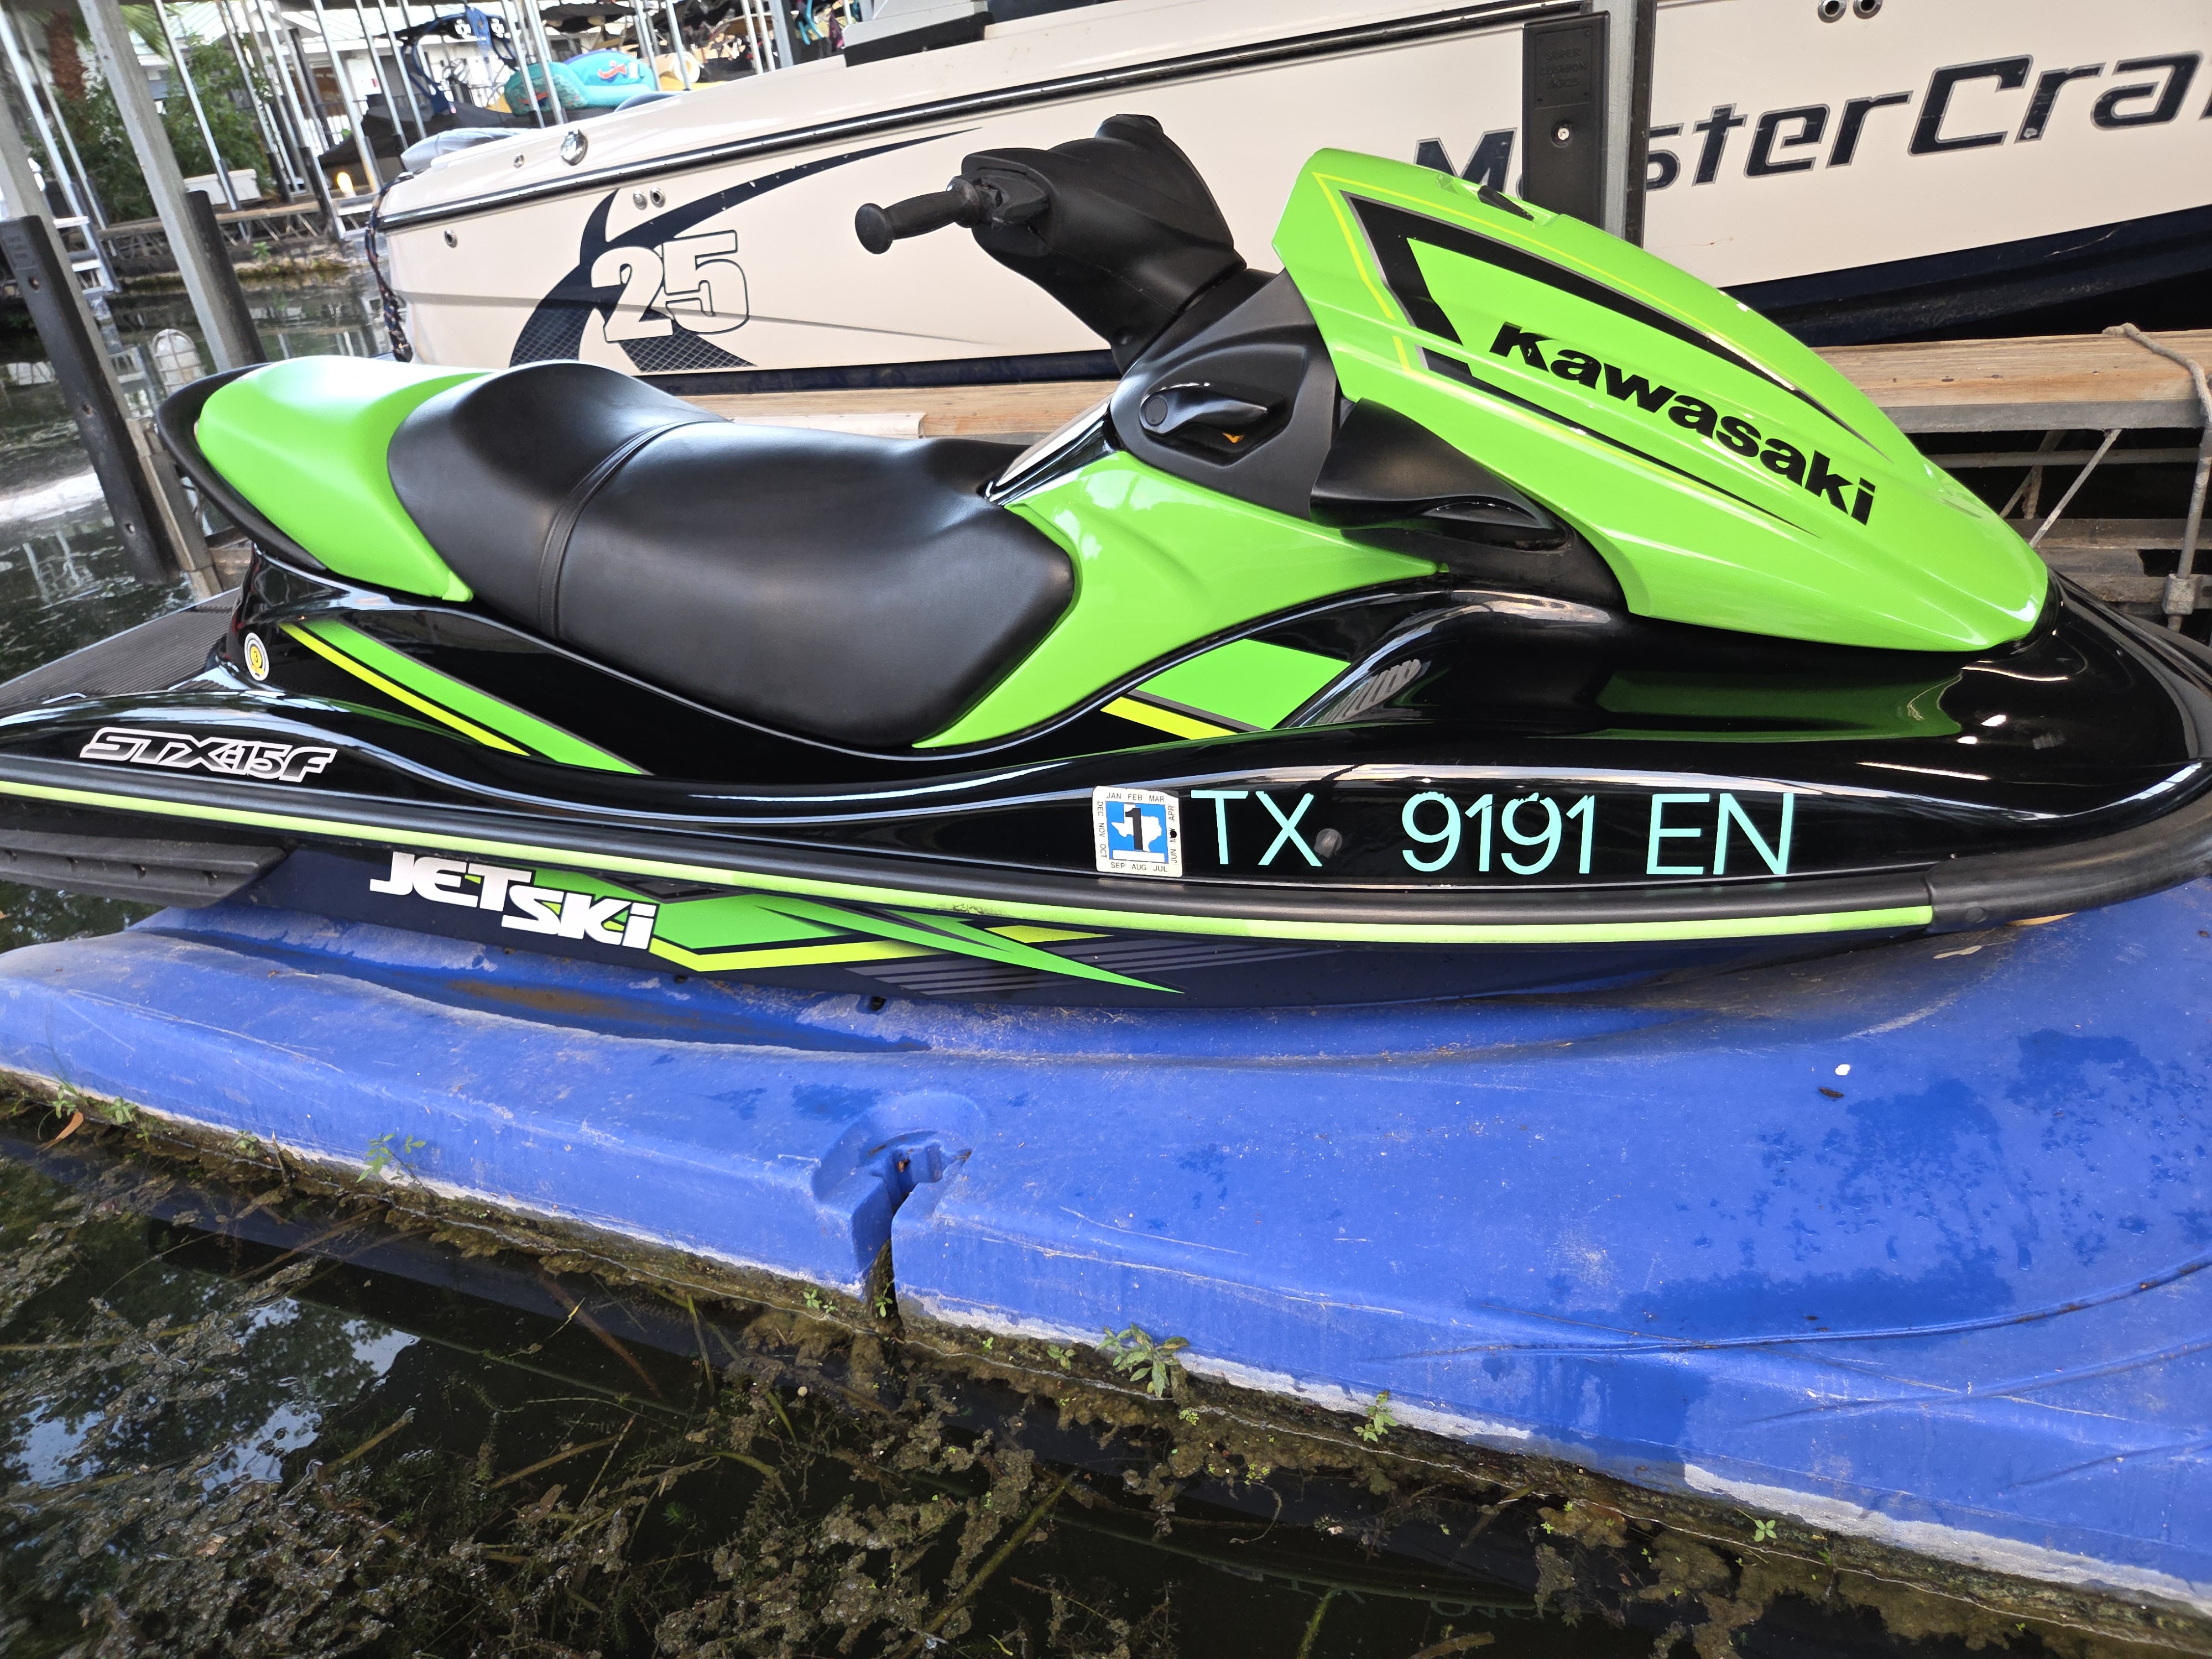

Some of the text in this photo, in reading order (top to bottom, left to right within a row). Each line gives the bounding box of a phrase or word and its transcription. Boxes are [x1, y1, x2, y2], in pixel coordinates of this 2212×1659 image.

[591, 229, 750, 344] 25
[1489, 321, 1876, 526] Kawasaki
[1125, 807, 1144, 851] 1
[1191, 790, 1794, 875] TX 9191 EN
[369, 852, 532, 911] JET
